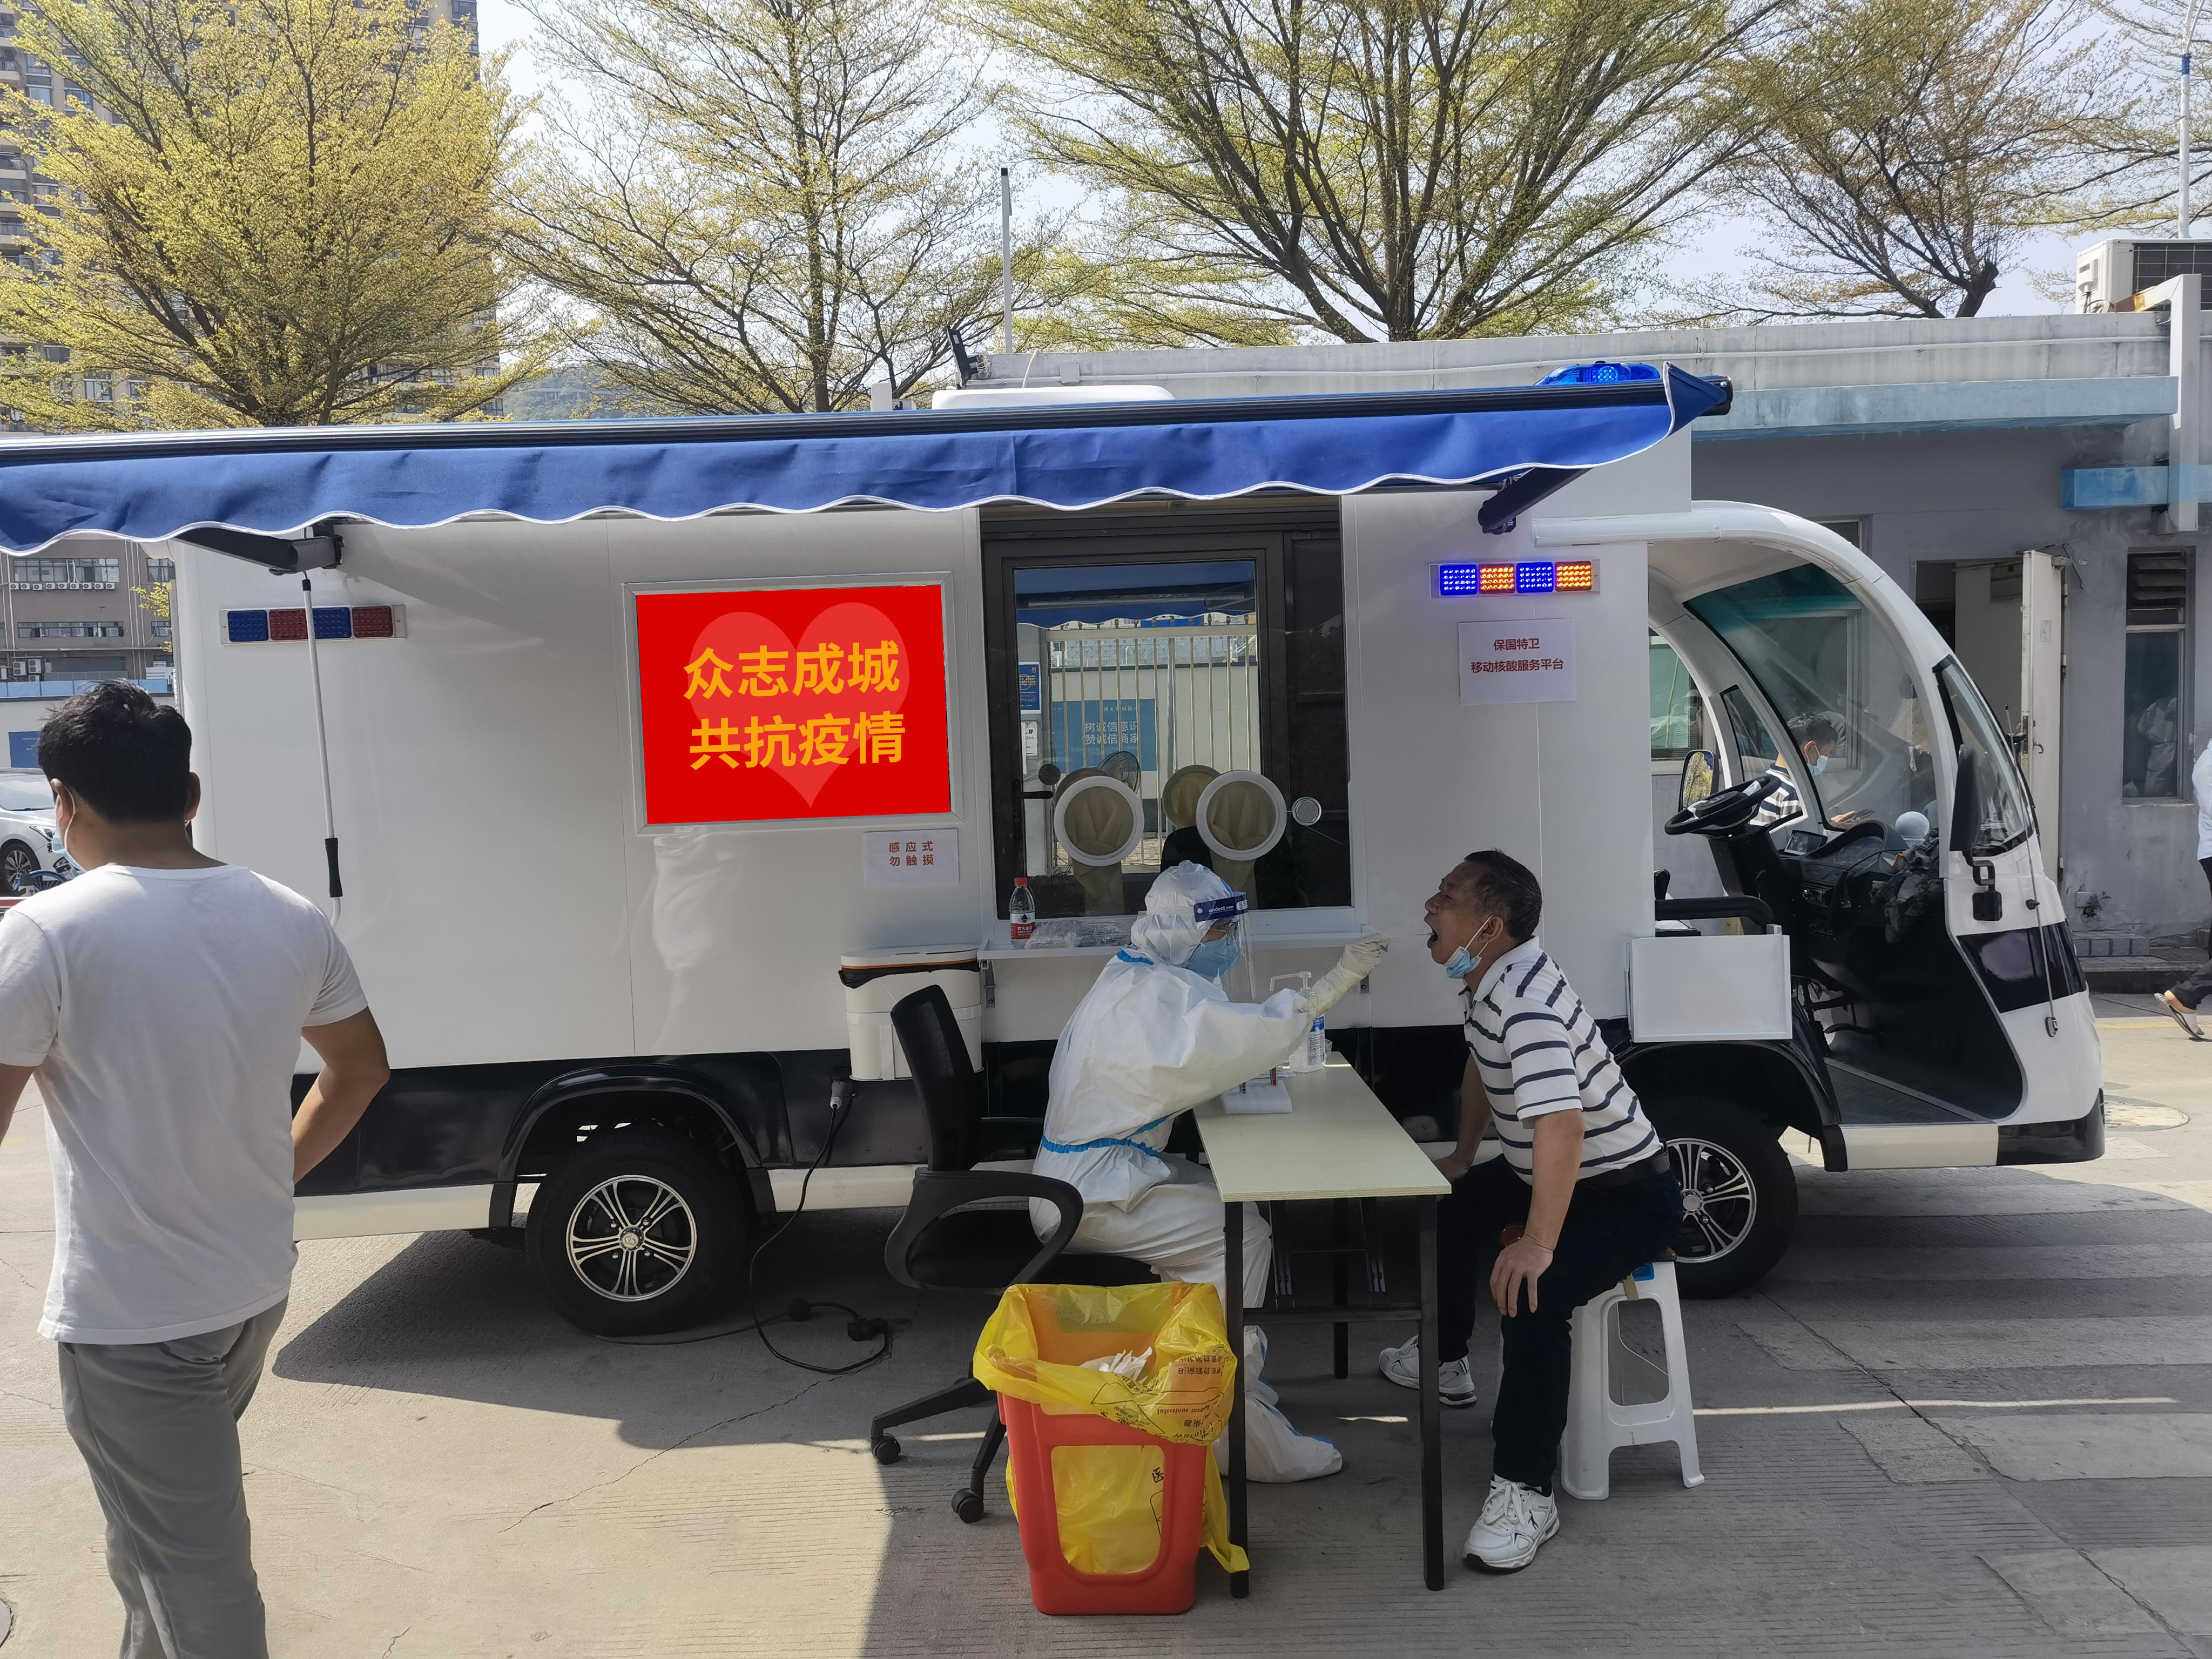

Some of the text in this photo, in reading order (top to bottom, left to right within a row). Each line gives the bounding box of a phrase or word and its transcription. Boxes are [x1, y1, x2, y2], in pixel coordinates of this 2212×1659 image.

[1493, 638, 1540, 651] 保国特卫
[683, 640, 900, 700] 众志成城
[1471, 658, 1564, 673] 移动核酸服务平台
[689, 711, 906, 771] 共抗疫情
[888, 840, 934, 853] 感应式
[889, 854, 934, 867] 勿触摸
